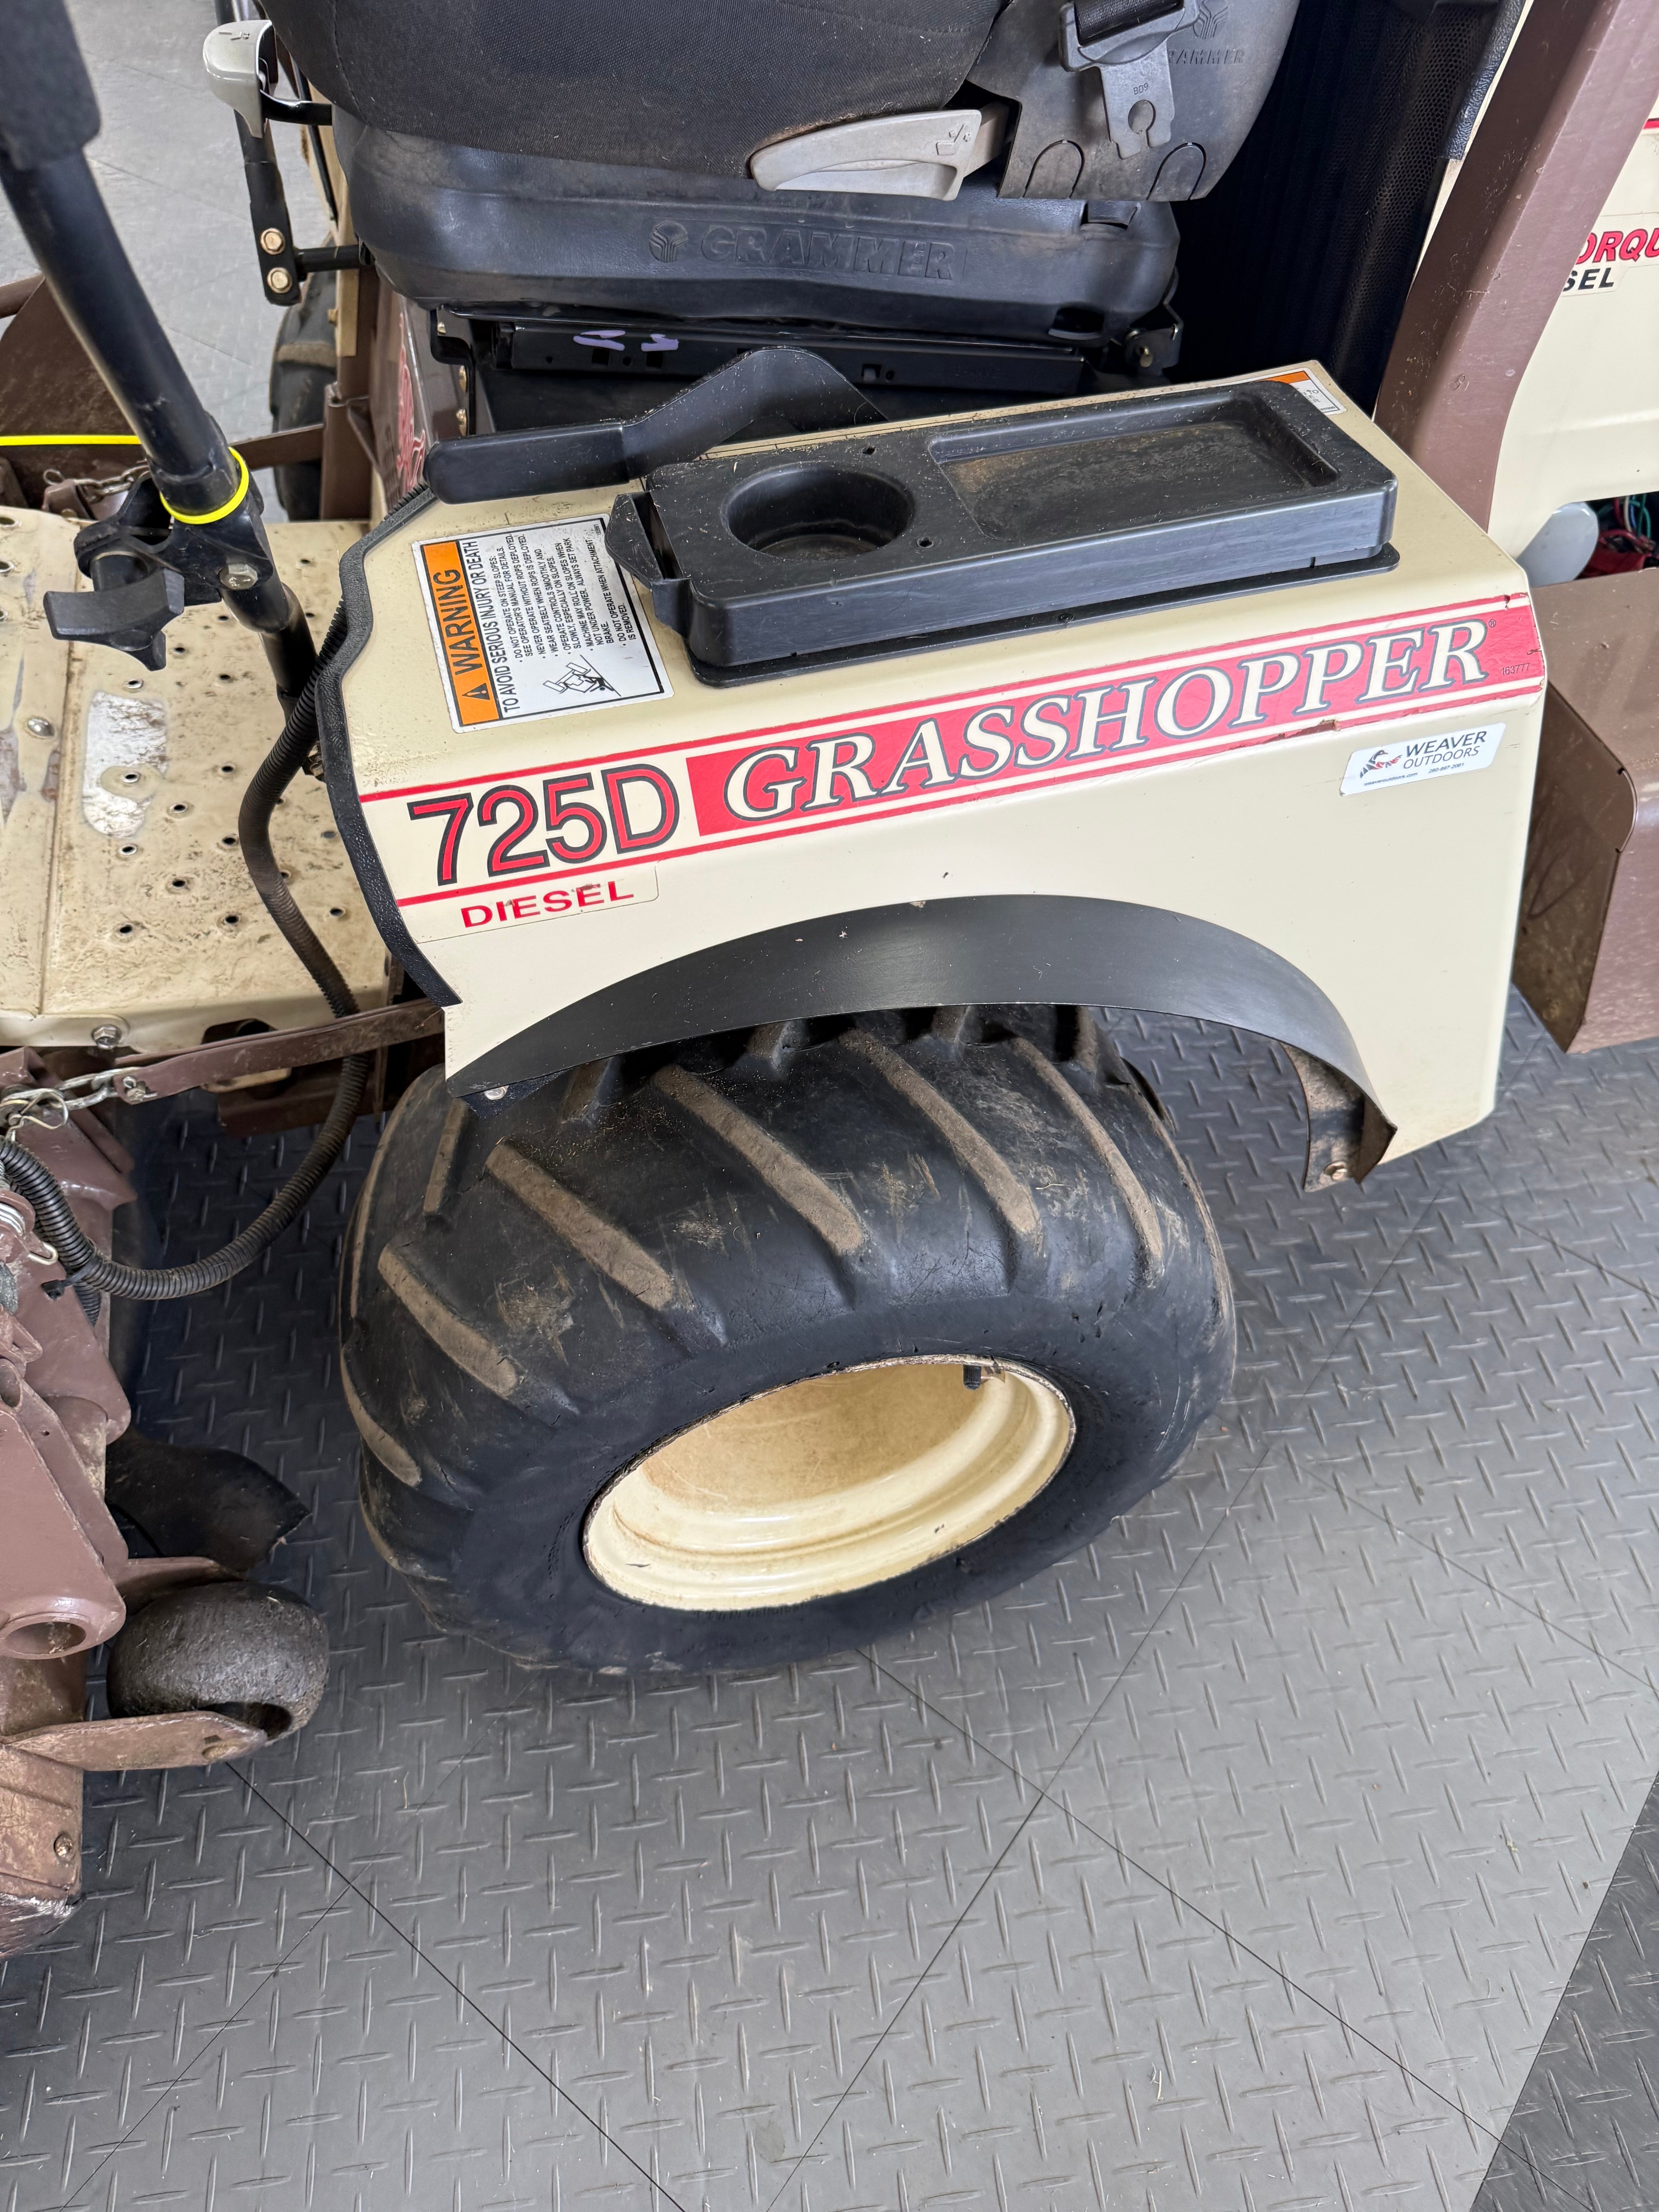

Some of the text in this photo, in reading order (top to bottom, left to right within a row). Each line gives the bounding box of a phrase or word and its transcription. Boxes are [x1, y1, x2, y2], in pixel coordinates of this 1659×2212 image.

[1167, 49, 1246, 64] RAMMER
[1133, 82, 1149, 95] B09
[701, 225, 954, 280] GRAMMER
[1562, 267, 1614, 292] SEL
[517, 534, 532, 564] DEPLOYED.
[513, 564, 524, 580] ROPS
[528, 570, 539, 586] ROPS
[496, 546, 533, 656] SEE OPERATOR'S MANUAL FOR DETAILS.
[517, 581, 531, 606] WITHOUT
[532, 587, 544, 604] WHEN
[534, 549, 571, 650] OPERATE CONTROLS SMOOTHLY AND
[546, 556, 581, 649] SLOWLY, ESPECIALLY ON SLOPES.
[554, 543, 594, 647] MACHINE MAY ROLL ON SLOPES WHEN
[562, 538, 604, 645] NOT UNDER POWER. ALWAYS SET PARK
[585, 539, 627, 642] DO NOT OPERATE WHEN ATTACHMENT
[489, 555, 523, 658] DO NOT OPERATE ON STEEP SLOPES:
[525, 606, 539, 633] OPERATE
[538, 605, 553, 634] SEATBELT
[618, 603, 634, 633] REMOVED.
[433, 570, 481, 674] WARNING
[462, 541, 520, 713] TO AVOID SERIOUS INJURY OR DEATH
[600, 621, 614, 643] BRAKE.
[533, 634, 546, 654] NEVER
[546, 634, 558, 653] WEAR
[1501, 663, 1530, 675] 163777
[1403, 745, 1479, 769] OUTDOORS
[1406, 730, 1487, 757] WEAVER
[407, 764, 680, 886] 725D
[460, 880, 634, 928] DIESEL
